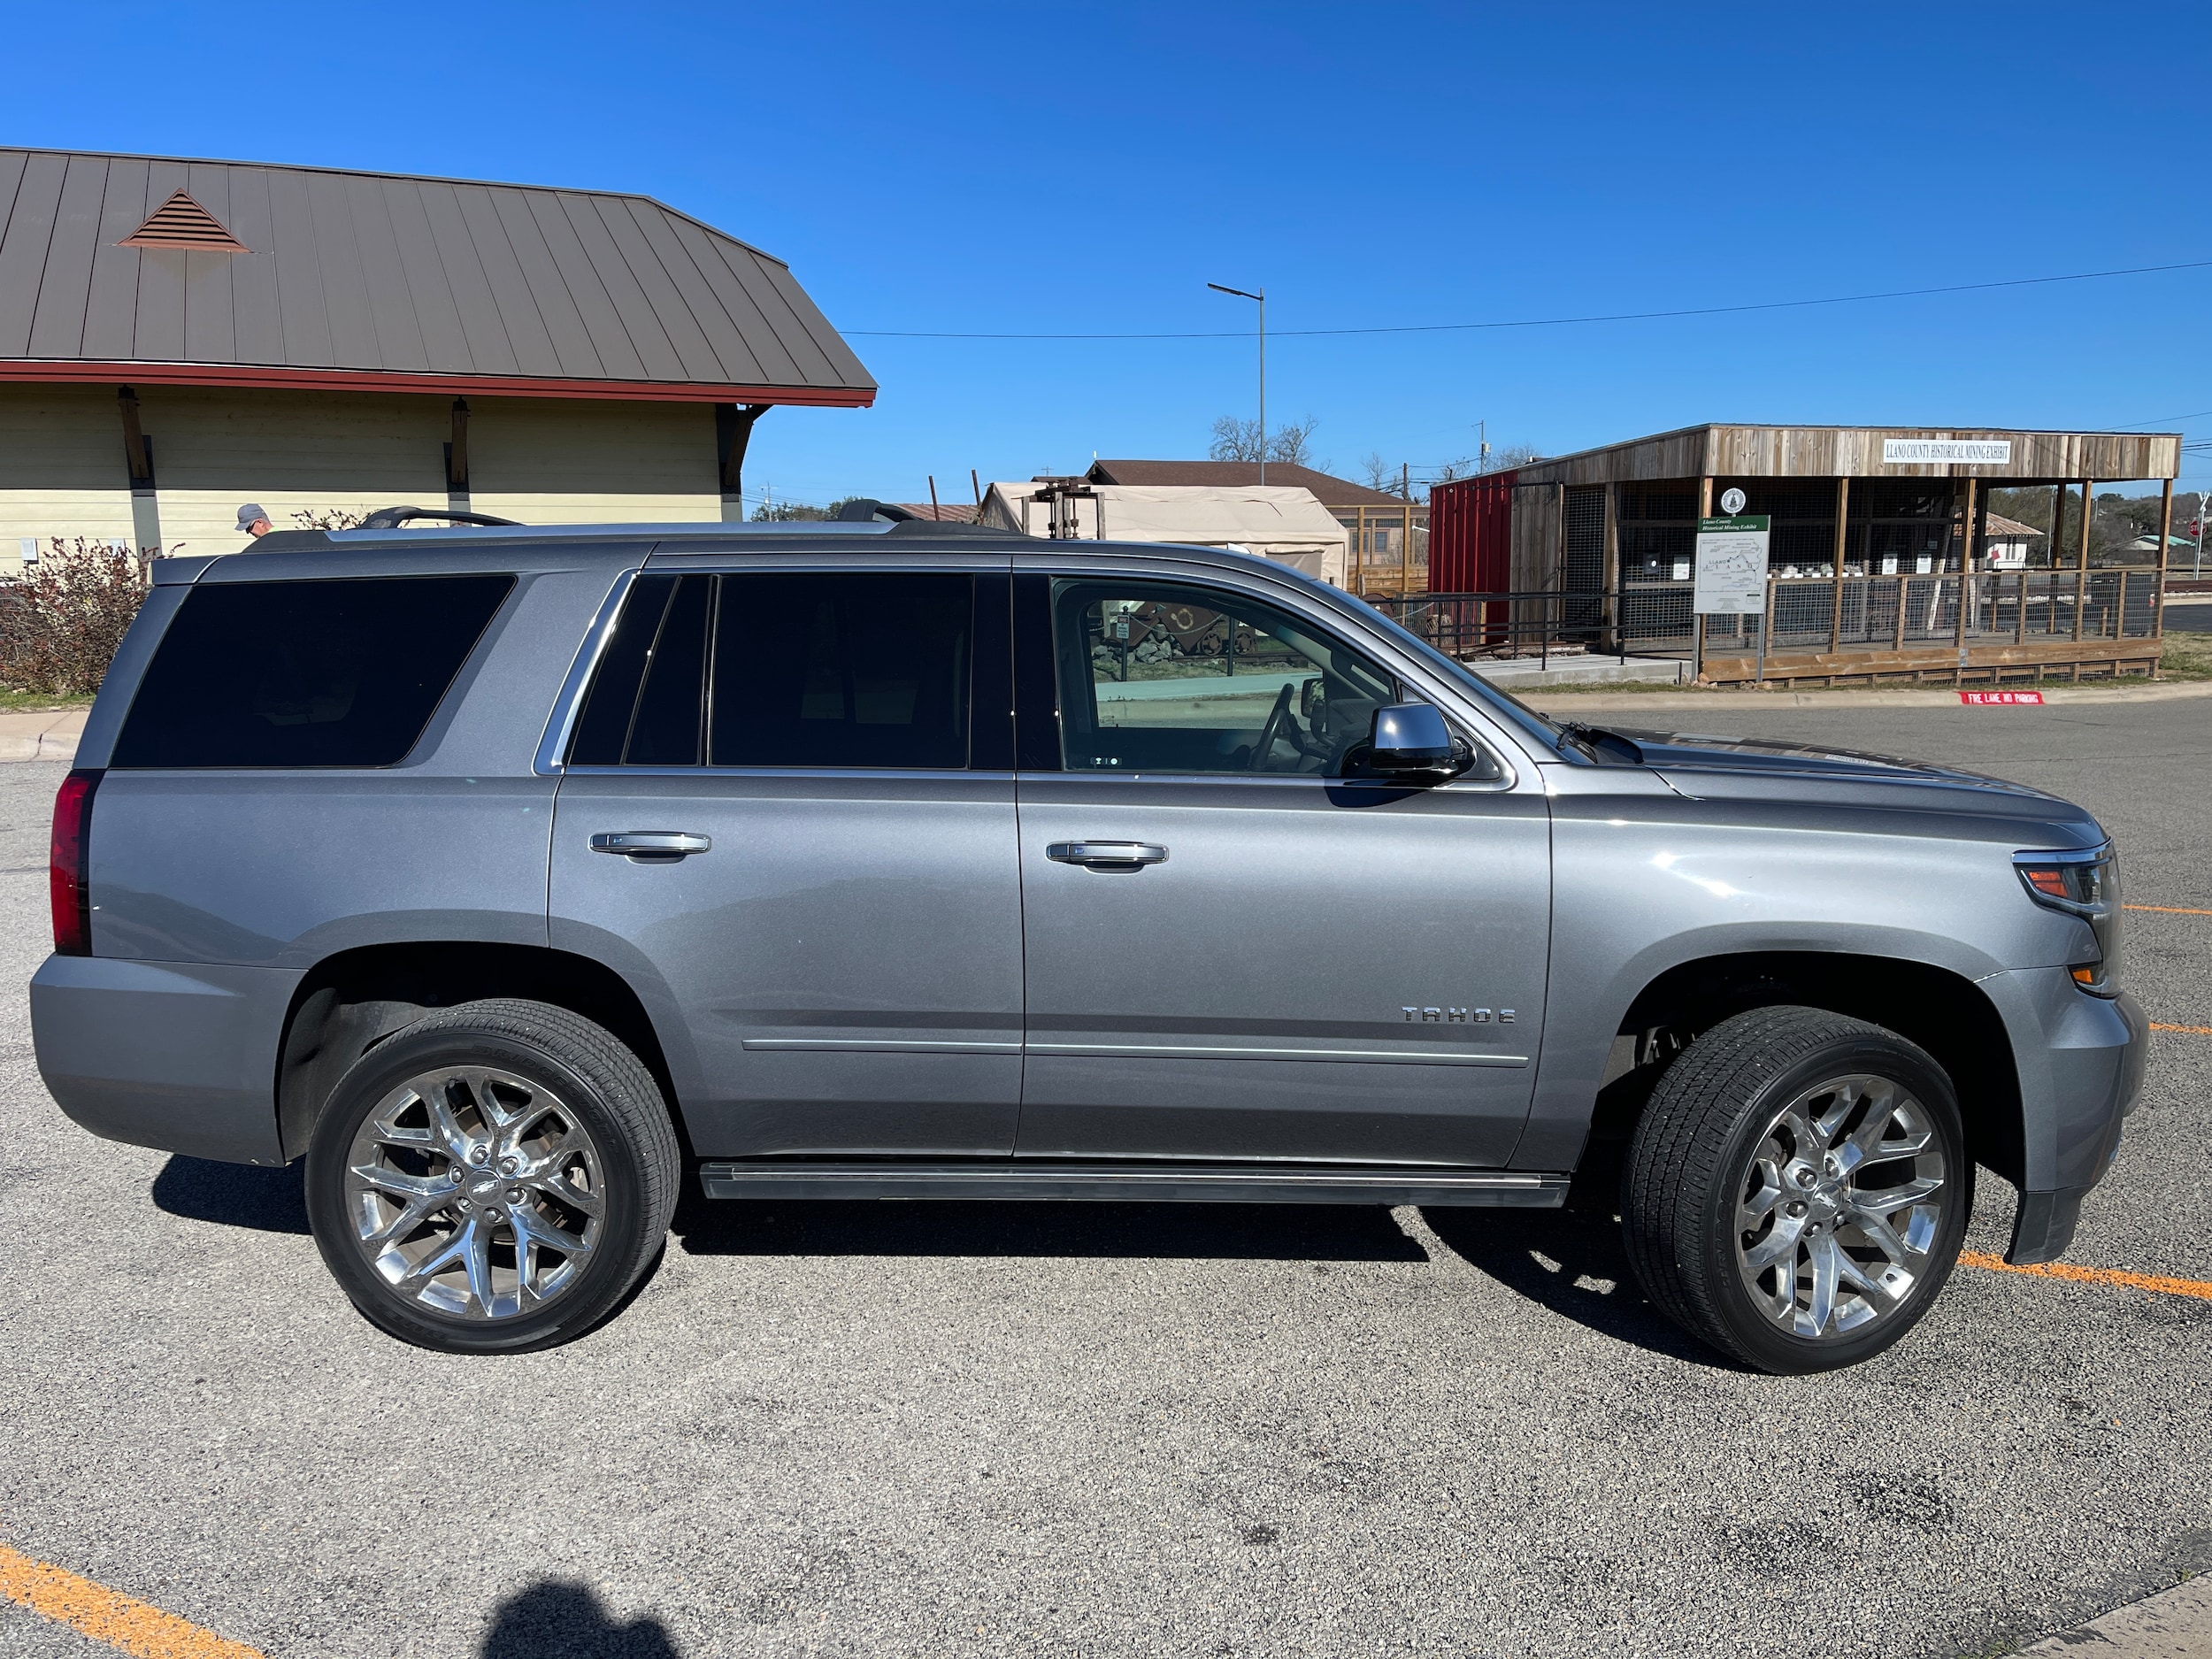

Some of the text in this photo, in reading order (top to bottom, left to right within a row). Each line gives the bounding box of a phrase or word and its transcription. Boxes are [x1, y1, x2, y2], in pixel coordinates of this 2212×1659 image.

[1886, 443, 2008, 459] LLANO COUNTY HISTORICAL MINING EXHIBIT
[1968, 693, 2039, 703] FIRE LANE NO PARKING
[1401, 1006, 1516, 1024] TAHOE
